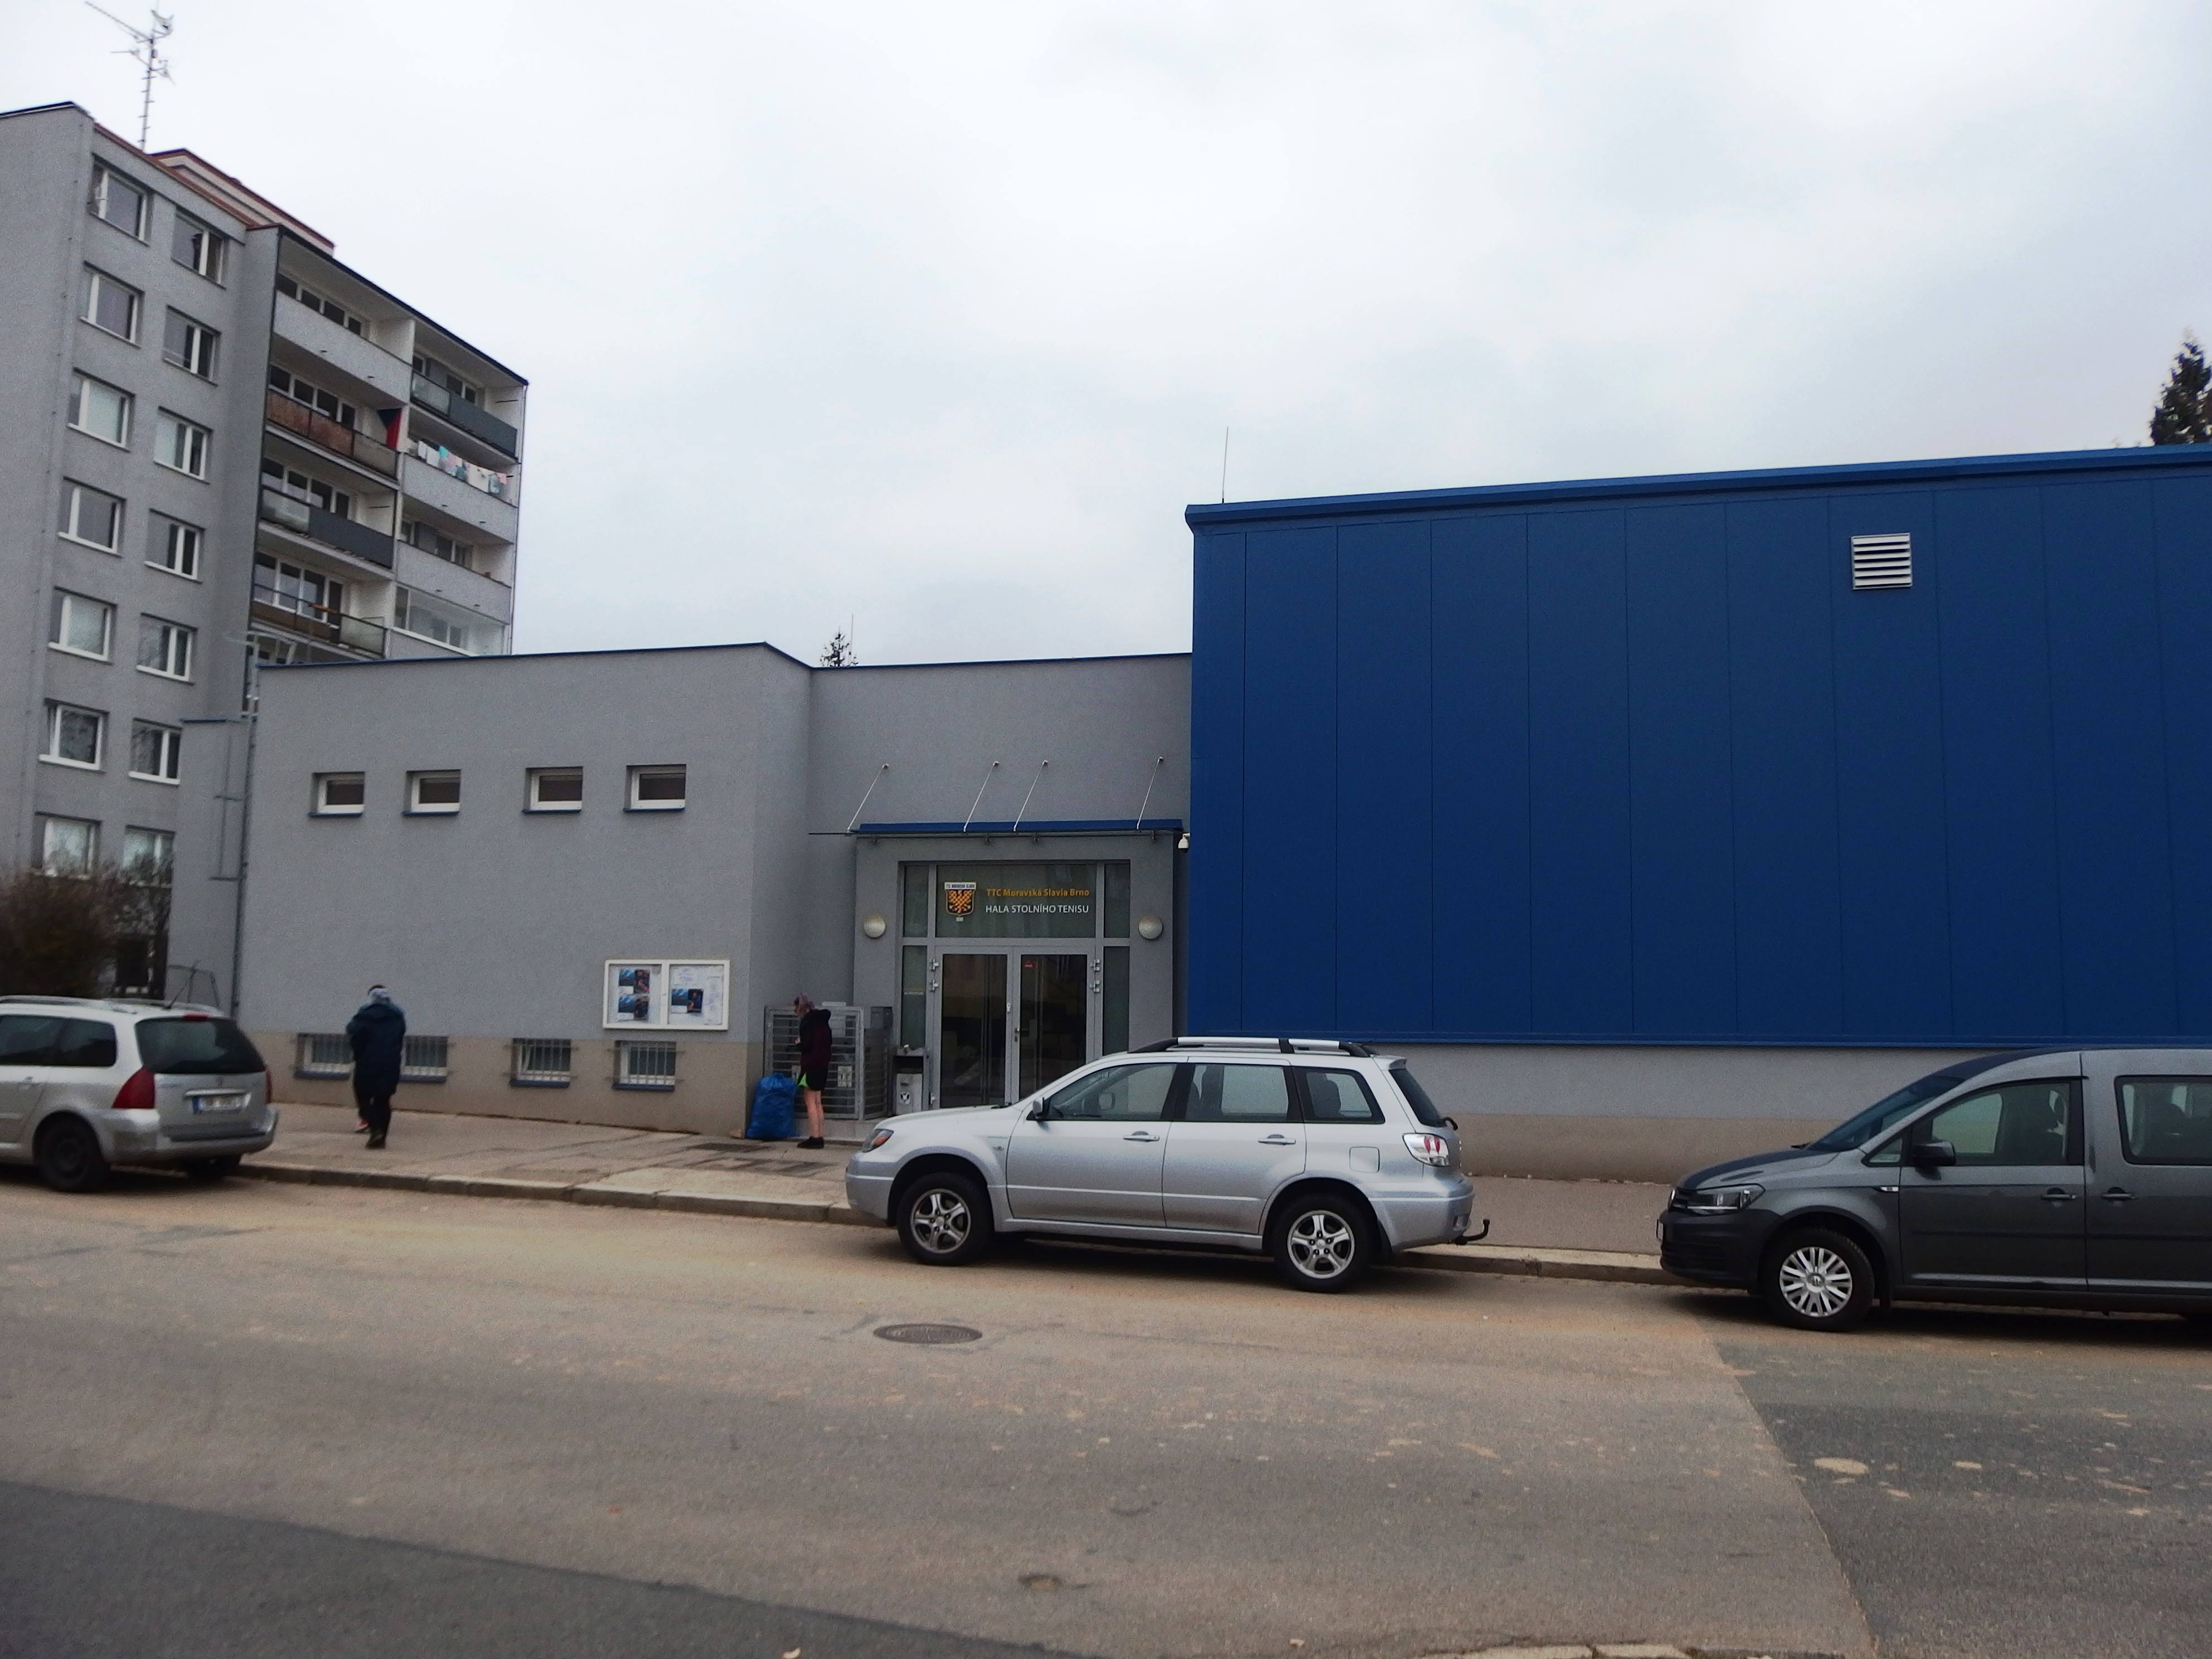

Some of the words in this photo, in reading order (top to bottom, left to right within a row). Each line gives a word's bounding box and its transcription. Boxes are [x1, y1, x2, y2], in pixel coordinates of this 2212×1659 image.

[986, 888, 1002, 896] TTC
[1003, 887, 1042, 896] Moravská
[1044, 888, 1068, 896] Slavia
[1070, 888, 1089, 896] Brno
[986, 905, 1009, 913] HALA
[1011, 903, 1056, 913] STOLNÍHO
[1058, 905, 1089, 913] TENISU
